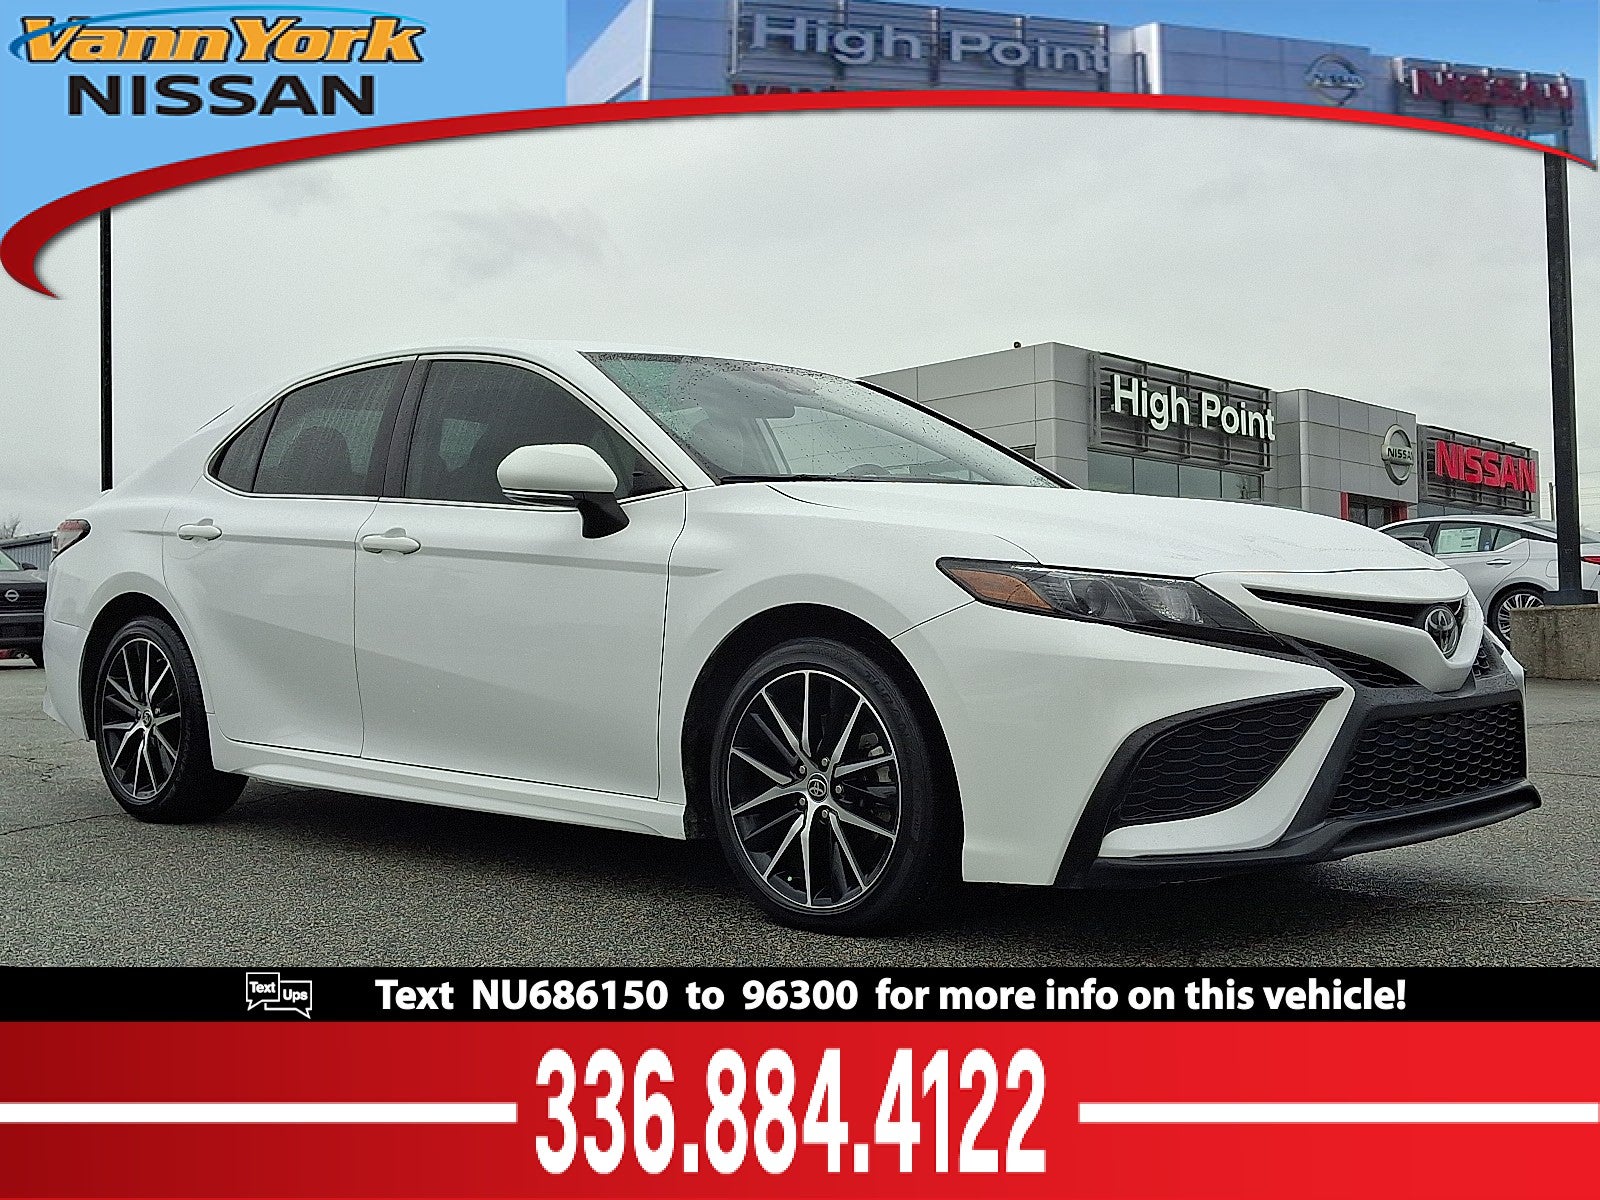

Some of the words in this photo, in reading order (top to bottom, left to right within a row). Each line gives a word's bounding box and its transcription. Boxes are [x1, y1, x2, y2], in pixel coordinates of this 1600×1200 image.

[1111, 374, 1190, 431] High
[1199, 391, 1276, 441] Point
[1387, 447, 1413, 460] NISSA
[1435, 440, 1536, 493] NISSAN
